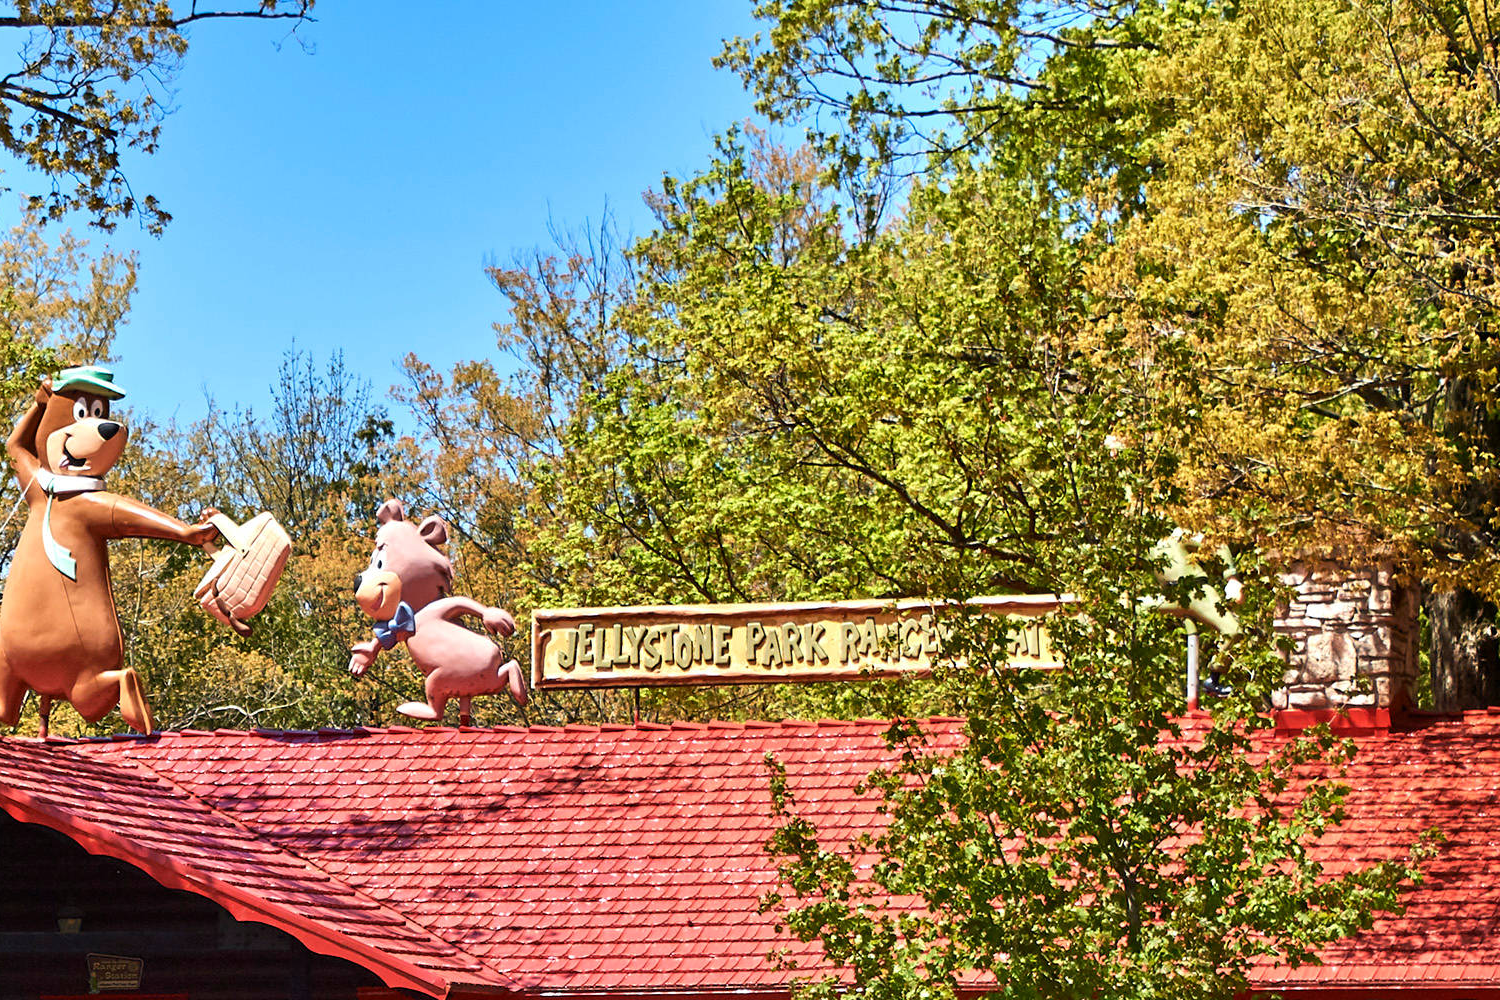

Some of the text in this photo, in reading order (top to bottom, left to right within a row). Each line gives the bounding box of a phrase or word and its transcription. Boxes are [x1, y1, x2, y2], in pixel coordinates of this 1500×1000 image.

[558, 623, 732, 670] JELLYSTONE
[746, 622, 830, 668] PARK
[840, 614, 950, 665] RANGE
